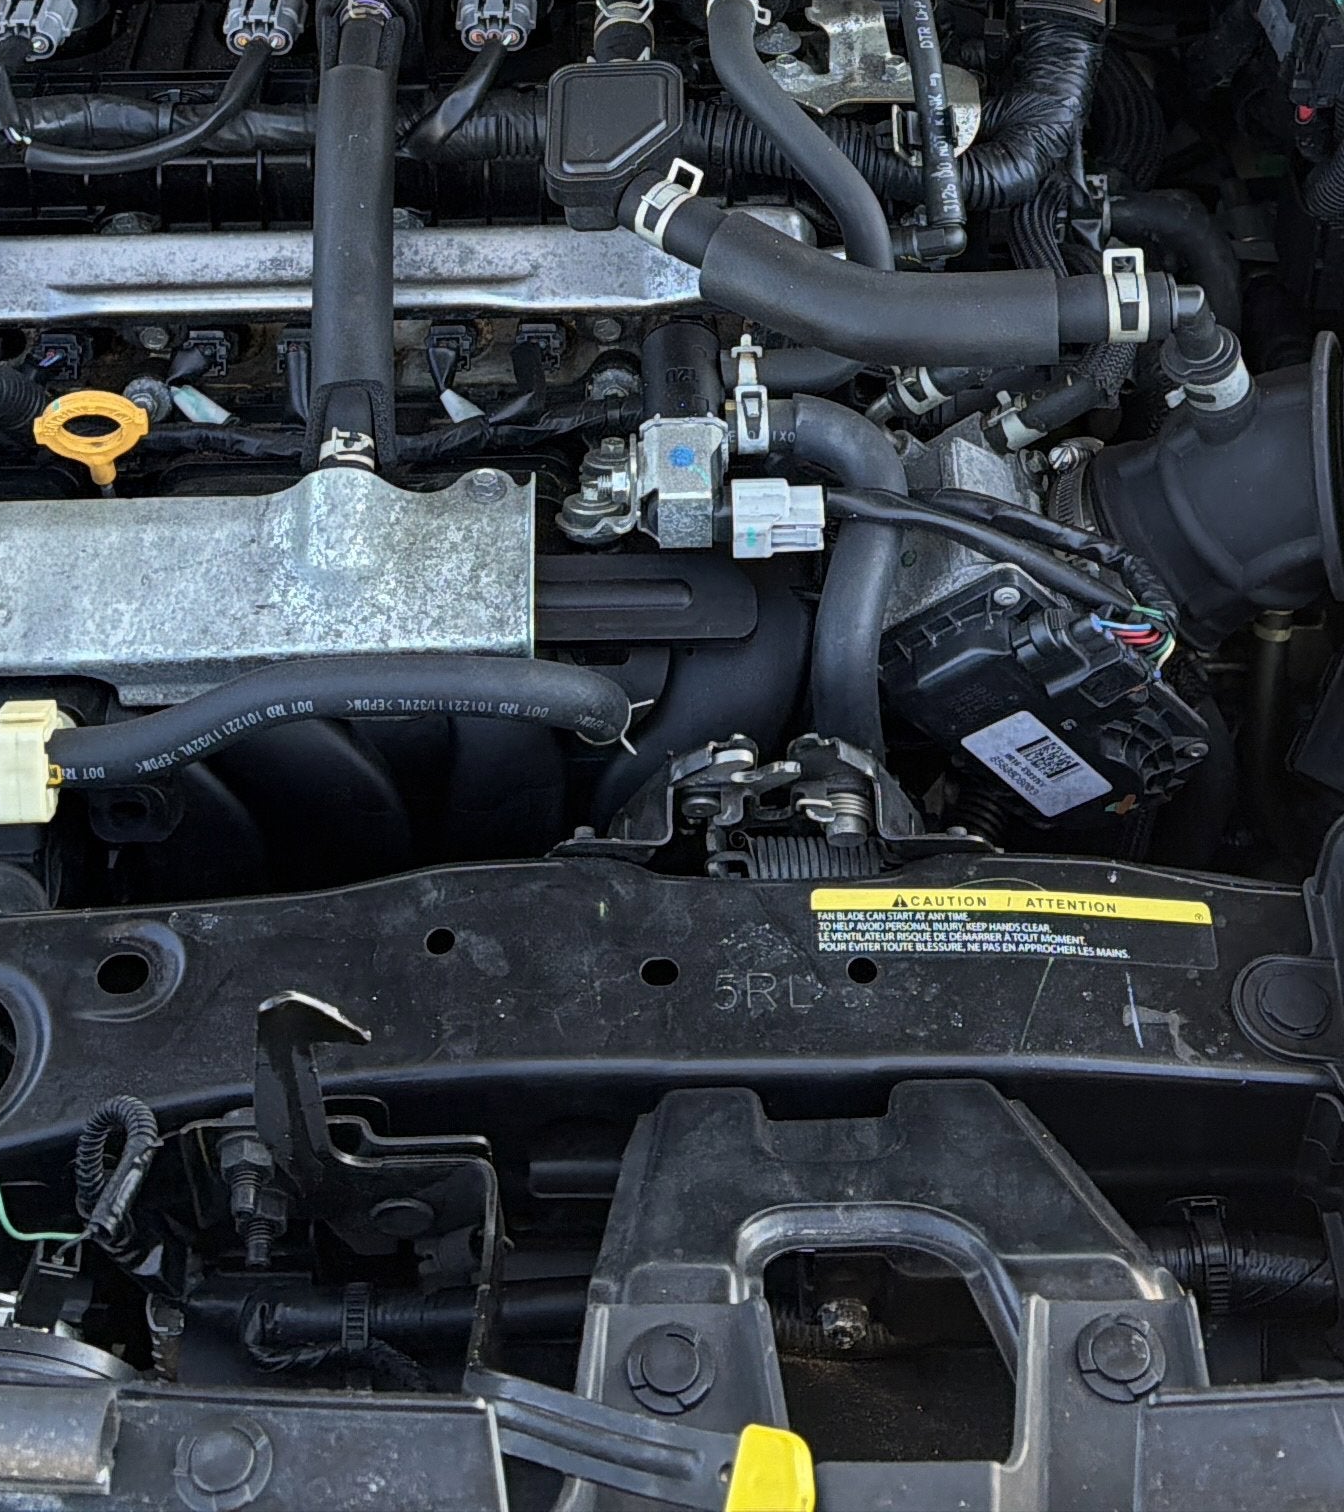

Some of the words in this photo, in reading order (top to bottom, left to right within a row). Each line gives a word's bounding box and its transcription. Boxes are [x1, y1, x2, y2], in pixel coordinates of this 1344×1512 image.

[917, 26, 934, 49] DTR
[291, 700, 315, 715] DOT
[522, 705, 550, 719] DOT
[82, 766, 105, 780] DOT
[910, 895, 987, 907] CAUTION
[1025, 897, 1117, 913] ATTENTION
[817, 911, 835, 921] FAN
[836, 911, 865, 921] BLADE
[866, 911, 886, 921] CAN
[887, 912, 914, 921] START
[915, 912, 926, 921] AT
[927, 912, 946, 921] ANY
[948, 912, 971, 921] TIME.
[818, 922, 831, 931] TO
[832, 922, 855, 931] HELP
[855, 922, 884, 931] AVOID
[885, 922, 932, 931] PERSONAL
[932, 922, 965, 933] INJURY,
[966, 922, 988, 931] KEEP
[989, 922, 1020, 932] HANDS
[1022, 922, 1052, 933] CLEAR.
[818, 932, 831, 942] LE
[831, 932, 895, 942] VENTILATEUR
[896, 932, 931, 942] RISQUE
[933, 932, 948, 942] DE
[948, 931, 1002, 942] DÉMARRER
[1011, 932, 1038, 942] TOUT
[1040, 933, 1087, 945] MOMENT.
[818, 942, 847, 952] POUR
[848, 941, 881, 952] ÉVITER
[882, 942, 914, 952] TOUTE
[916, 942, 966, 953] BLESSURE,
[967, 942, 981, 952] NE
[982, 942, 1001, 952] PAS
[1002, 942, 1016, 952] EN
[1018, 943, 1076, 955] APPROCHER
[1077, 946, 1095, 956] LES
[1096, 947, 1131, 959] MAINS.
